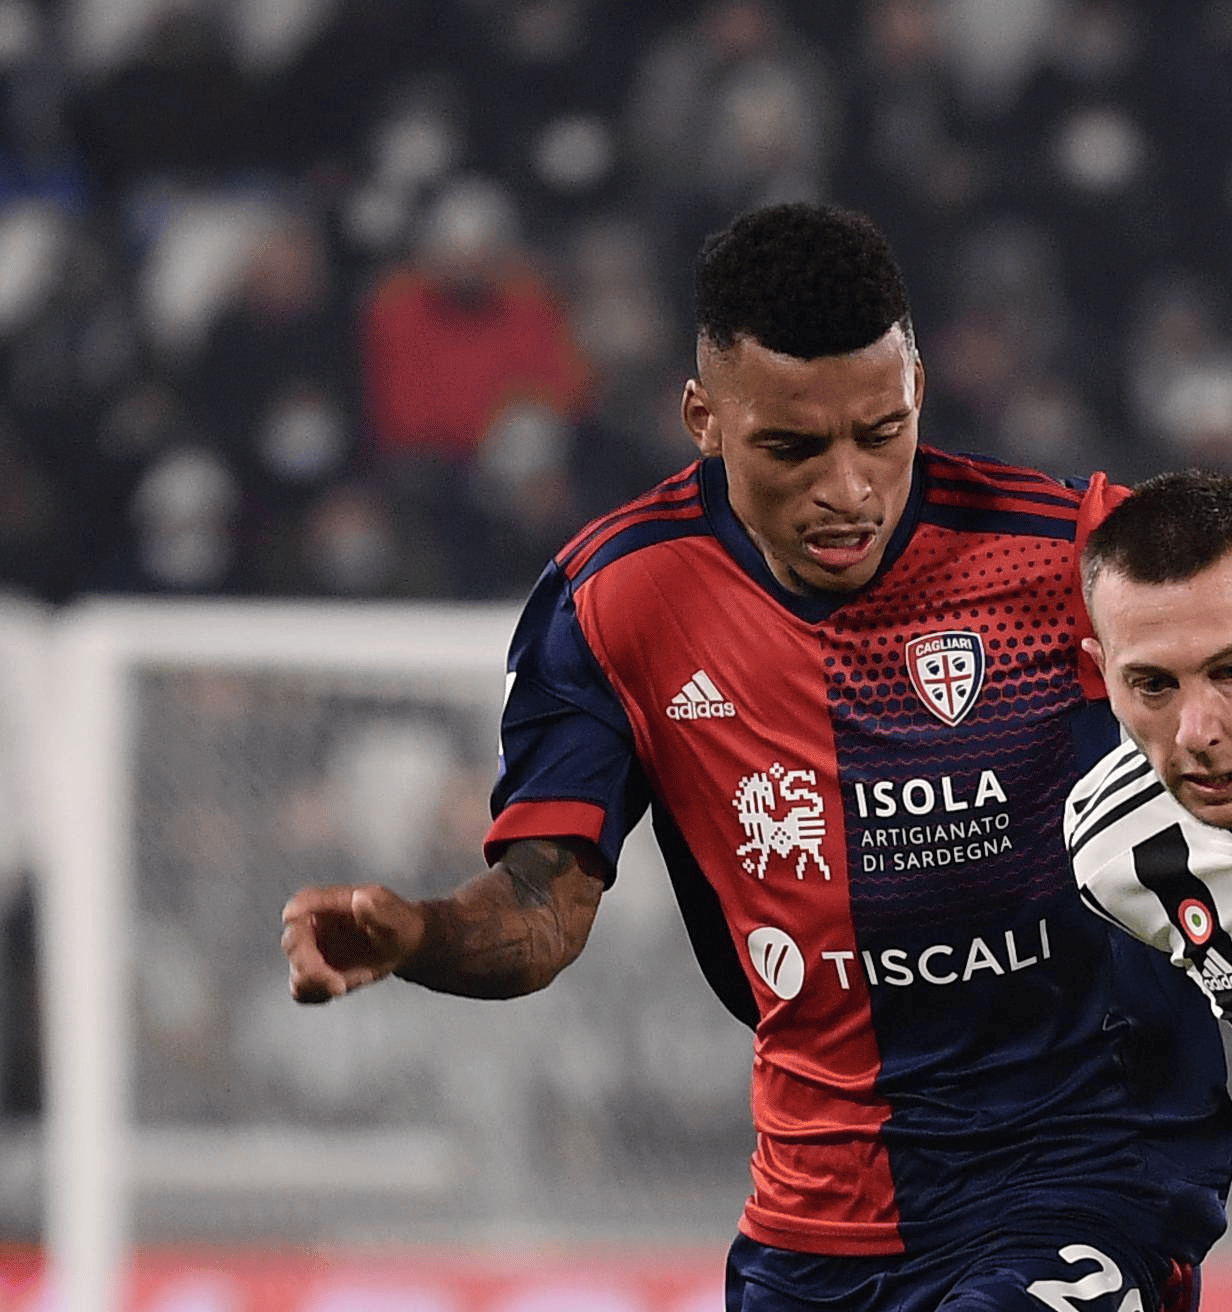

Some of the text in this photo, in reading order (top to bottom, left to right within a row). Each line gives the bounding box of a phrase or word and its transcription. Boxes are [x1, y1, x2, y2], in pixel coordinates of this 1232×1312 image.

[915, 637, 973, 657] CAGLIARI
[666, 700, 736, 720] adidas
[855, 769, 1008, 818] ISOLA
[861, 813, 1010, 848] ARTIGIANATO
[863, 837, 1013, 872] DI SARDEGNA
[821, 918, 1052, 991] TISCALI
